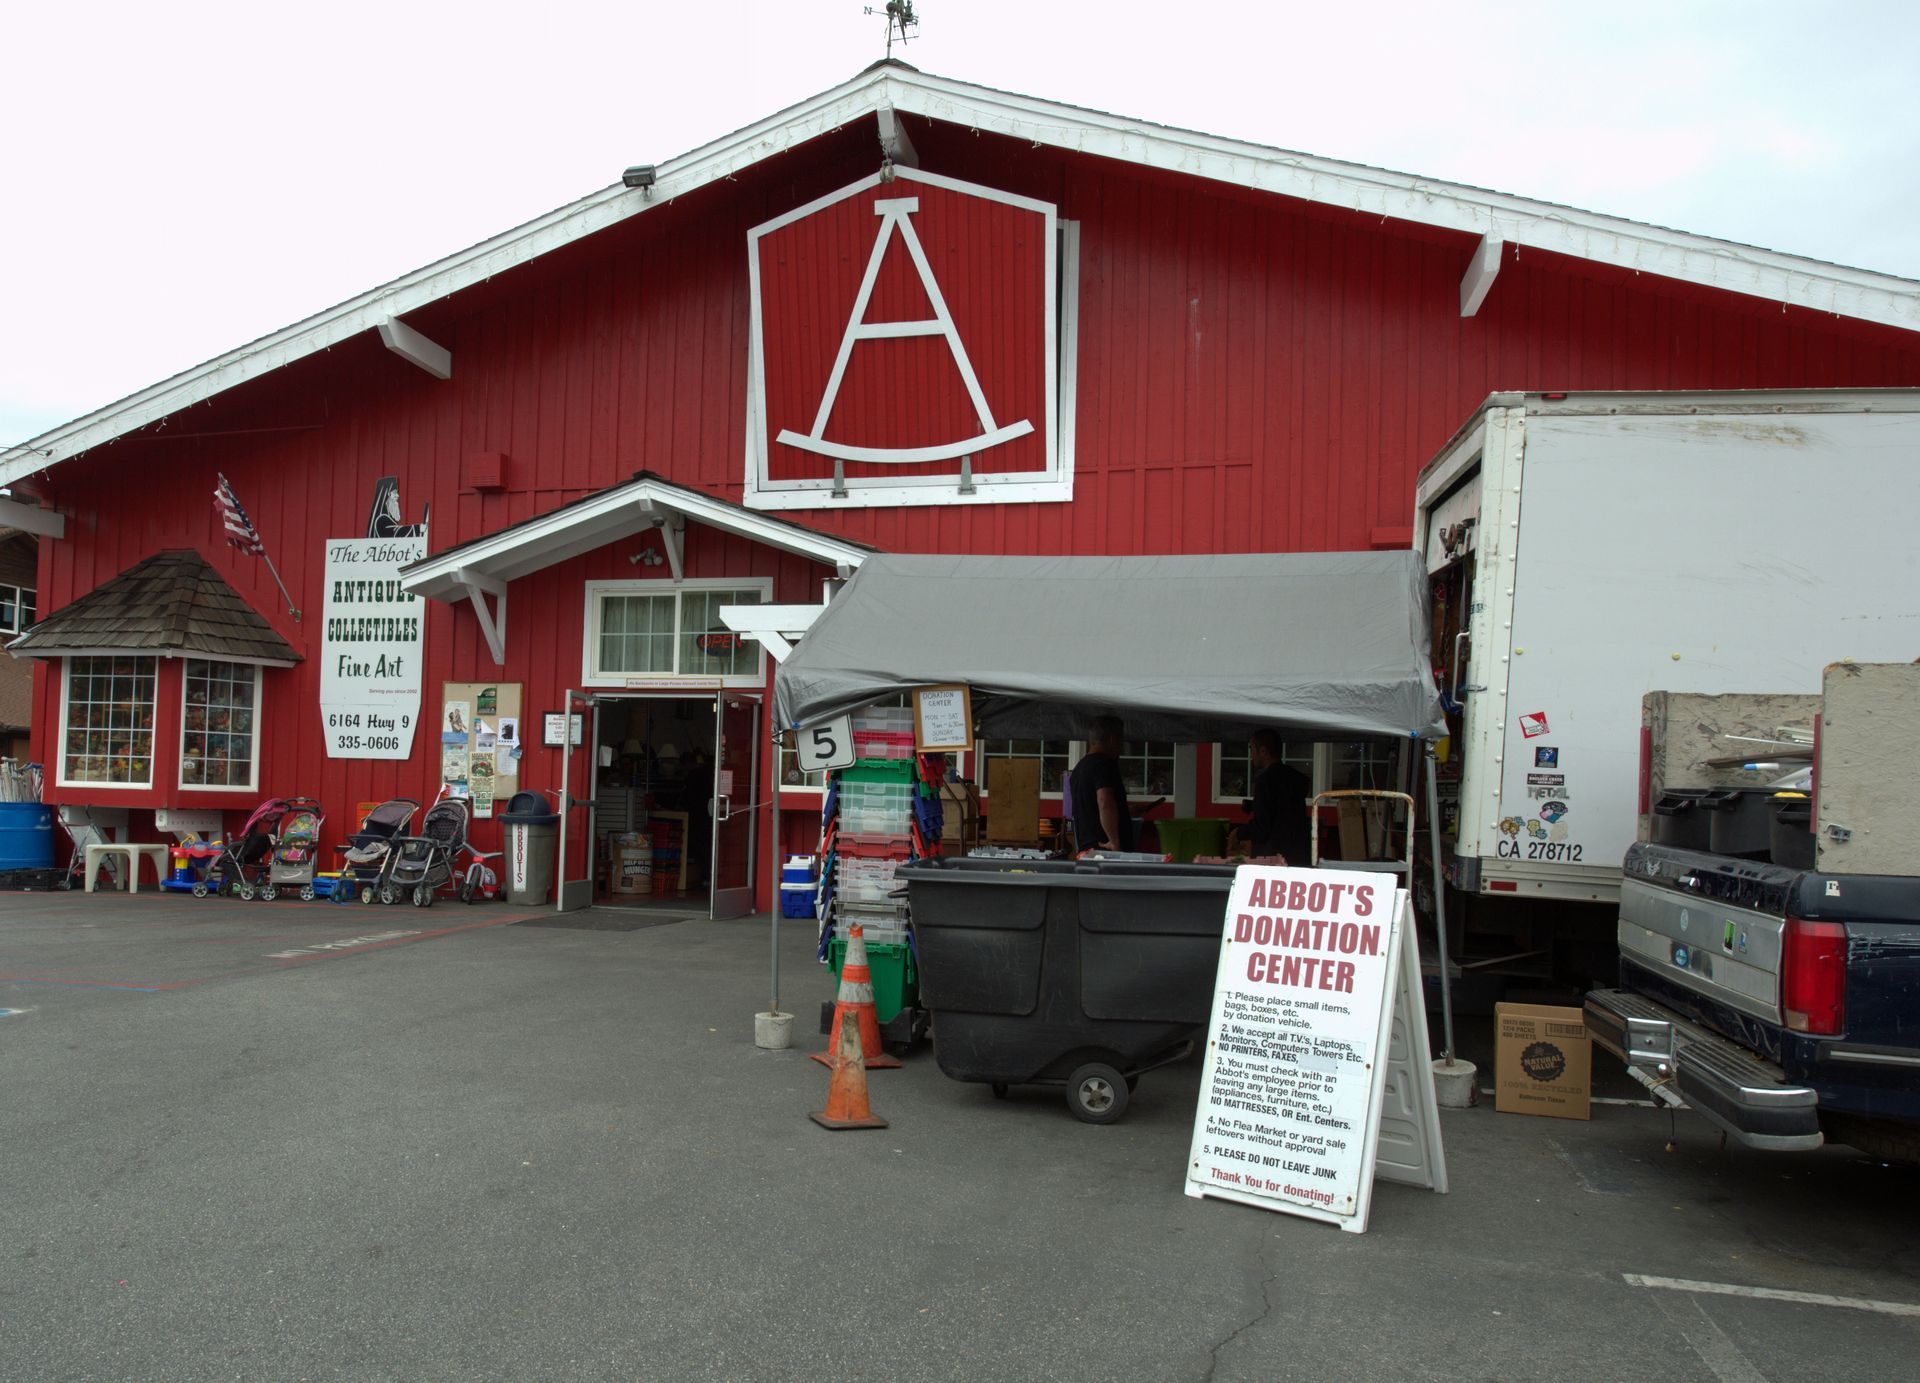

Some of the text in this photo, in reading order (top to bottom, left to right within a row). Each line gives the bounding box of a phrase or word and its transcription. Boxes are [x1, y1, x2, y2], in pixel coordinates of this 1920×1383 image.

[864, 6, 873, 15] N
[776, 197, 1035, 463] A
[330, 543, 423, 563] The Abbot's
[328, 618, 418, 642] COLLECTIBLES
[700, 633, 745, 649] OPEN
[338, 654, 404, 678] Fine Art
[922, 691, 954, 699] DONATION
[329, 714, 410, 732] 6164 Hwy 9
[338, 735, 399, 750] 335-0606
[812, 727, 837, 760] 5
[1498, 840, 1583, 862] CA 278712
[1248, 878, 1374, 916] ABBOT'S
[1234, 914, 1380, 956] DONATION
[1247, 952, 1355, 993] CENTER
[1225, 1001, 1298, 1018] bags, boxes, etc.
[1235, 992, 1264, 1003] Please
[1267, 997, 1291, 1006] place
[1294, 1000, 1318, 1010] small
[1322, 1003, 1350, 1015] items,
[1224, 1010, 1312, 1030] by donation vehicle.
[1220, 1033, 1363, 1063] Monitors, Computers Towers Etc.
[1222, 1024, 1228, 1032] 2.
[1232, 1025, 1244, 1034] We
[1246, 1028, 1276, 1039] accept
[1279, 1032, 1288, 1041] all
[1314, 1038, 1353, 1052] Laptops,
[1218, 1042, 1298, 1064] NO PRINTERS, FAXES,
[1524, 1055, 1562, 1066] NATURAL
[1216, 1066, 1334, 1093] Abbot's employee prior to
[1217, 1057, 1337, 1084] 3. You must check with an
[1212, 1085, 1332, 1115] (appliances, furniture, etc.)
[1214, 1076, 1320, 1101] leaving any large items.
[1210, 1096, 1351, 1130] NO MATTRESSES, OR Ent. Centers.
[1206, 1125, 1326, 1156] leftovers without approval
[1208, 1116, 1346, 1150] 4. No Flea Market or yard sale
[1204, 1145, 1338, 1180] 5. PLEASE DO NOT LEAVE JUNK
[1212, 1168, 1334, 1205] Thank You for donating!
